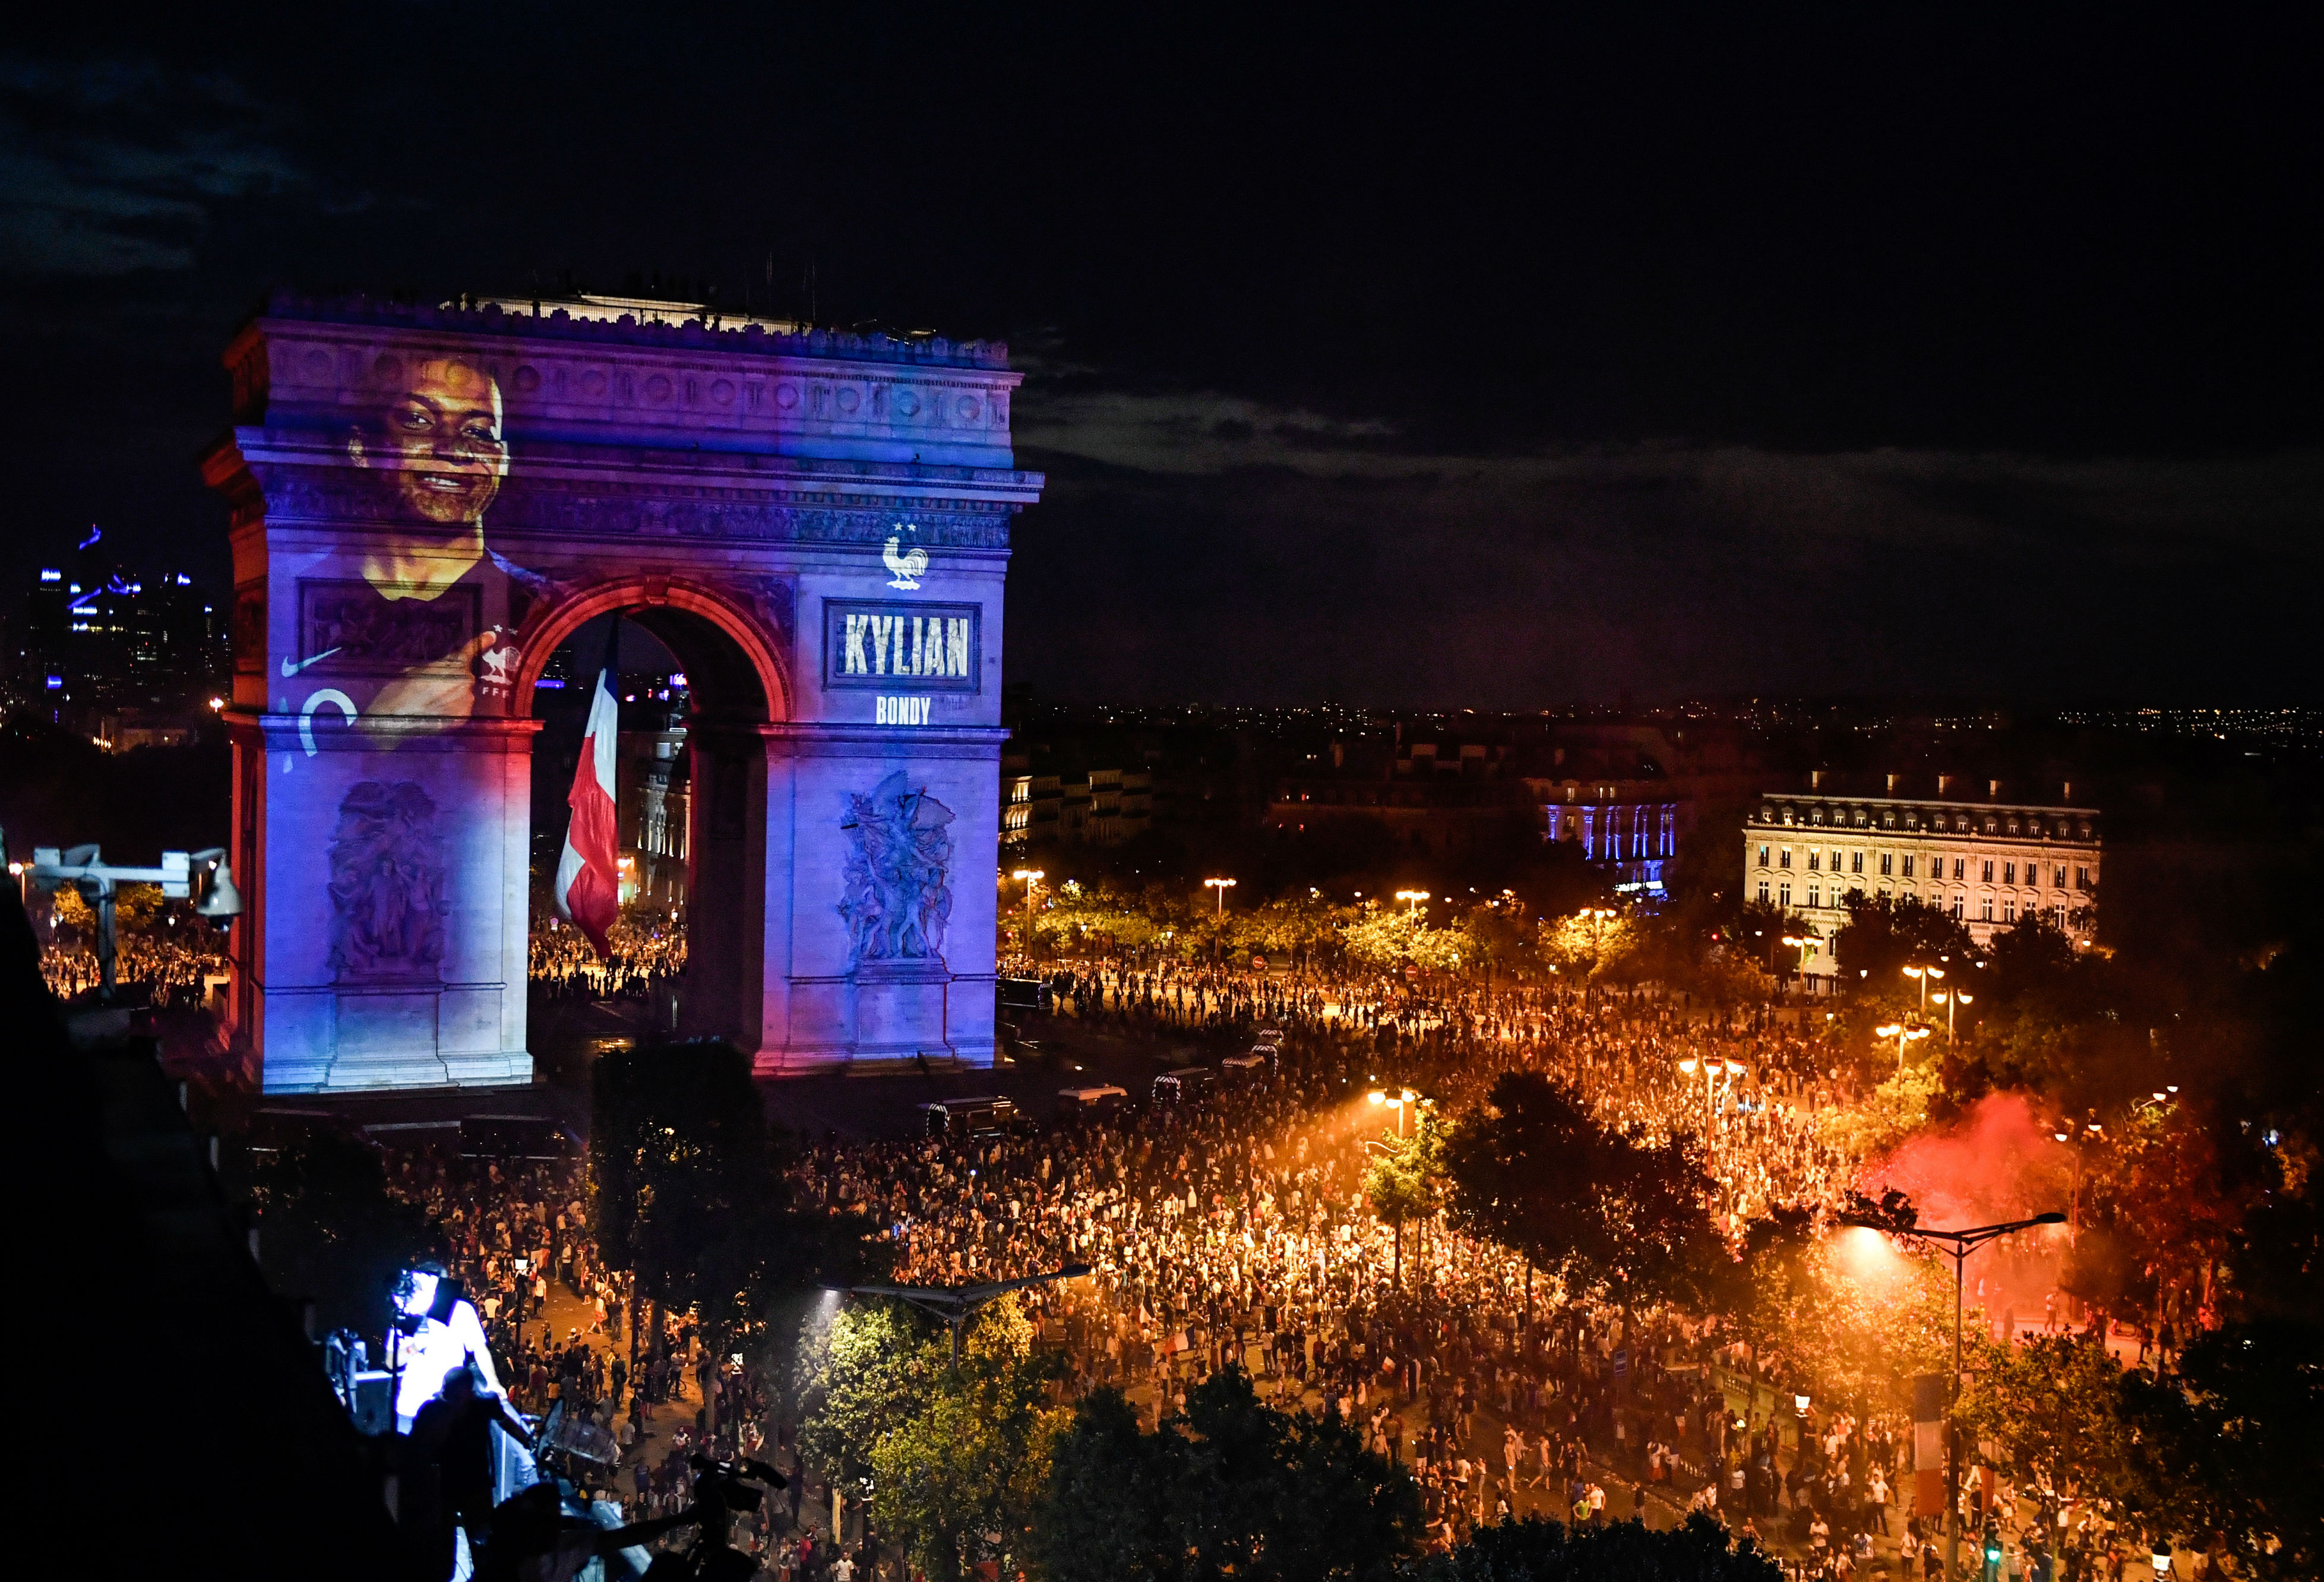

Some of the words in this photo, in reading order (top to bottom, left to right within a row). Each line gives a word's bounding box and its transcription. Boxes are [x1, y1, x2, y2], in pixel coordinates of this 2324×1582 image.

[845, 614, 968, 676] KYLIAN
[482, 687, 509, 698] FFF
[876, 696, 931, 725] BONDY
